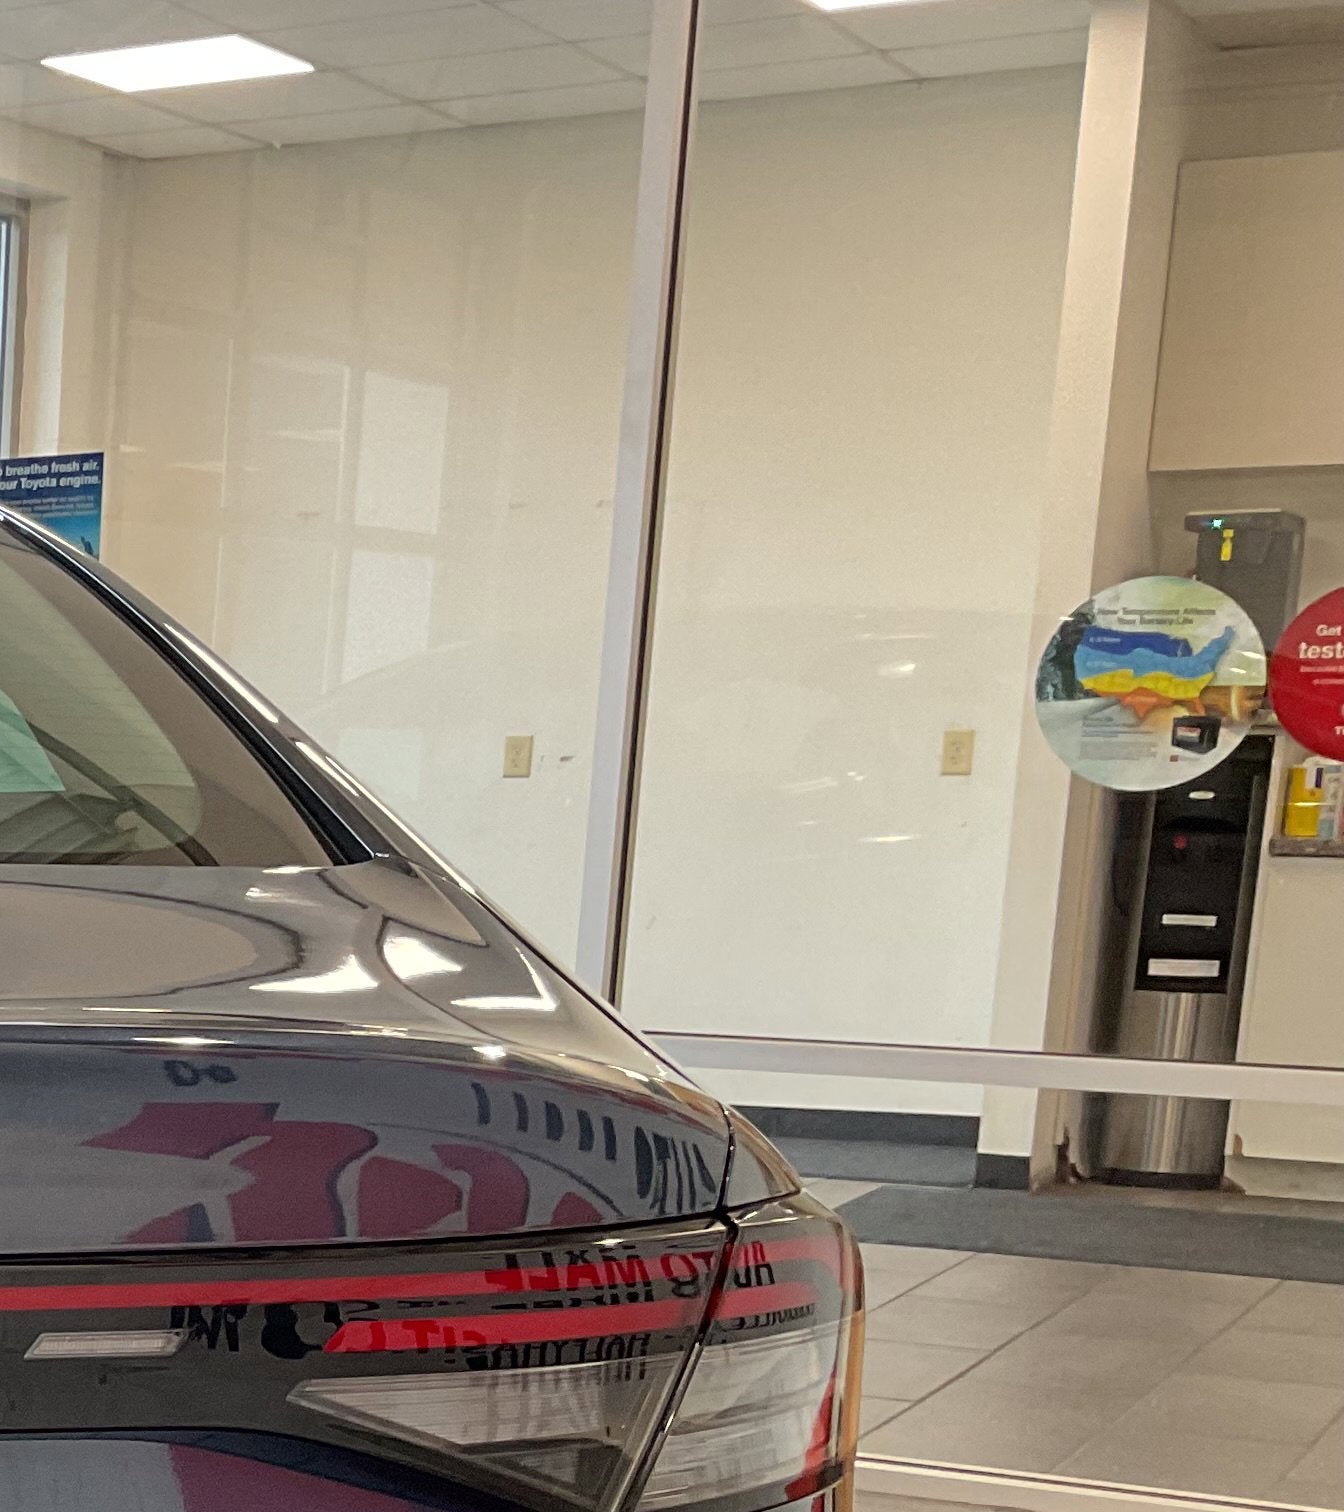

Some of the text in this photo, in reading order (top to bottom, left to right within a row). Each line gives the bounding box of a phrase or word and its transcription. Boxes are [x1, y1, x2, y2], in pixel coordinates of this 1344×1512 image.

[5, 463, 49, 477] breathe
[51, 461, 80, 474] fresh
[82, 459, 100, 472] air.
[20, 477, 57, 491] Toyota
[59, 474, 101, 489] engine.
[1316, 624, 1342, 637] Get
